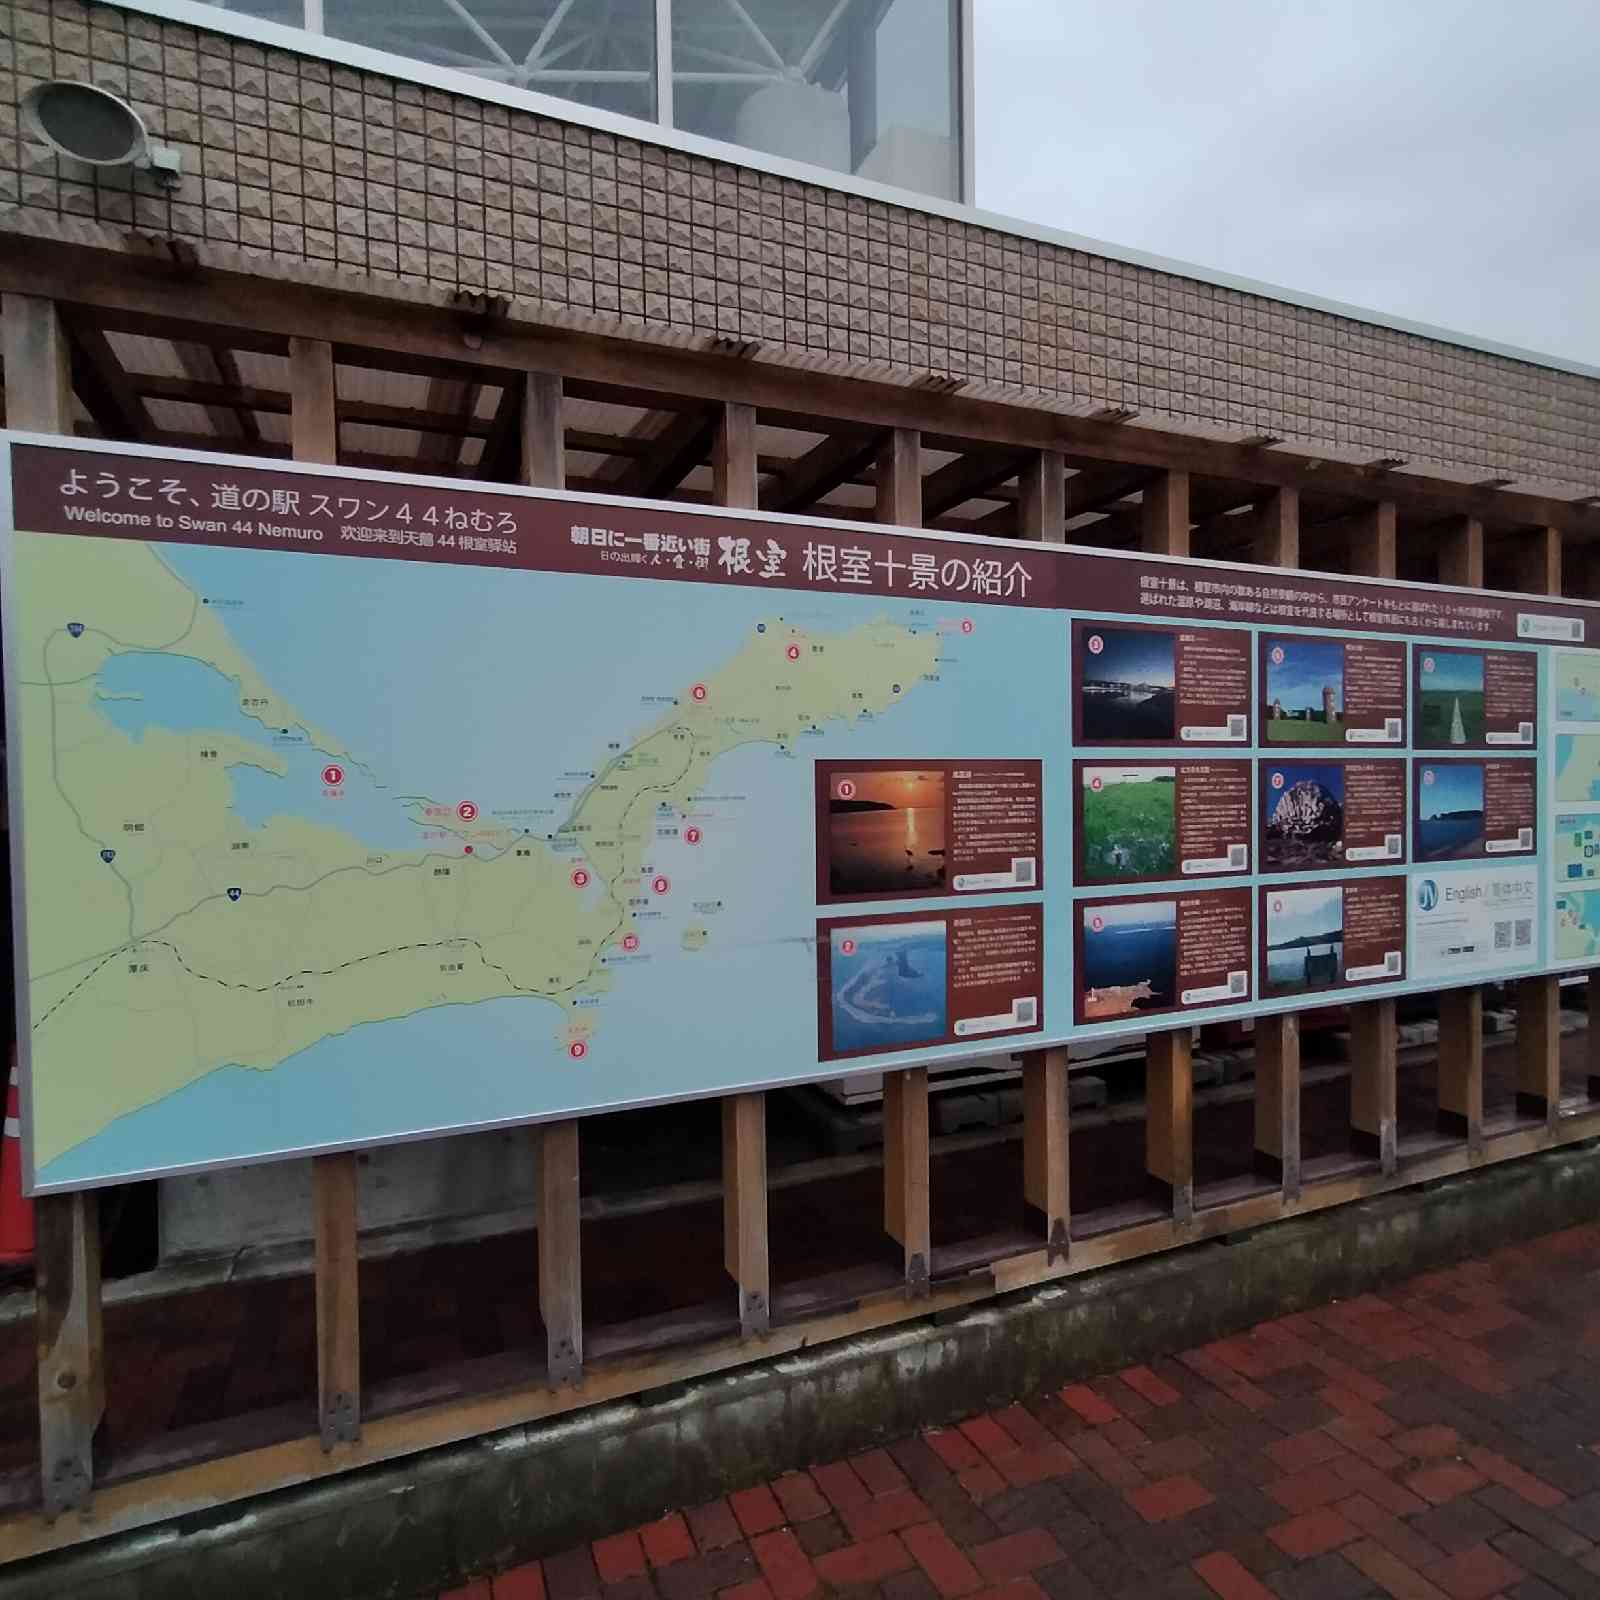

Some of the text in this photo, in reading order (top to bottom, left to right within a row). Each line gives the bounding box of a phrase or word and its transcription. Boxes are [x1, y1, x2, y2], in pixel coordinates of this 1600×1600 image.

[64, 505, 324, 541] Welcome to Swan 44 Nemuro
[437, 534, 455, 547] 44
[570, 525, 711, 556] 朝日に一番近い街
[718, 535, 787, 579] 根室
[802, 541, 1033, 598] 根室十景の紹介
[1445, 885, 1482, 903] English
